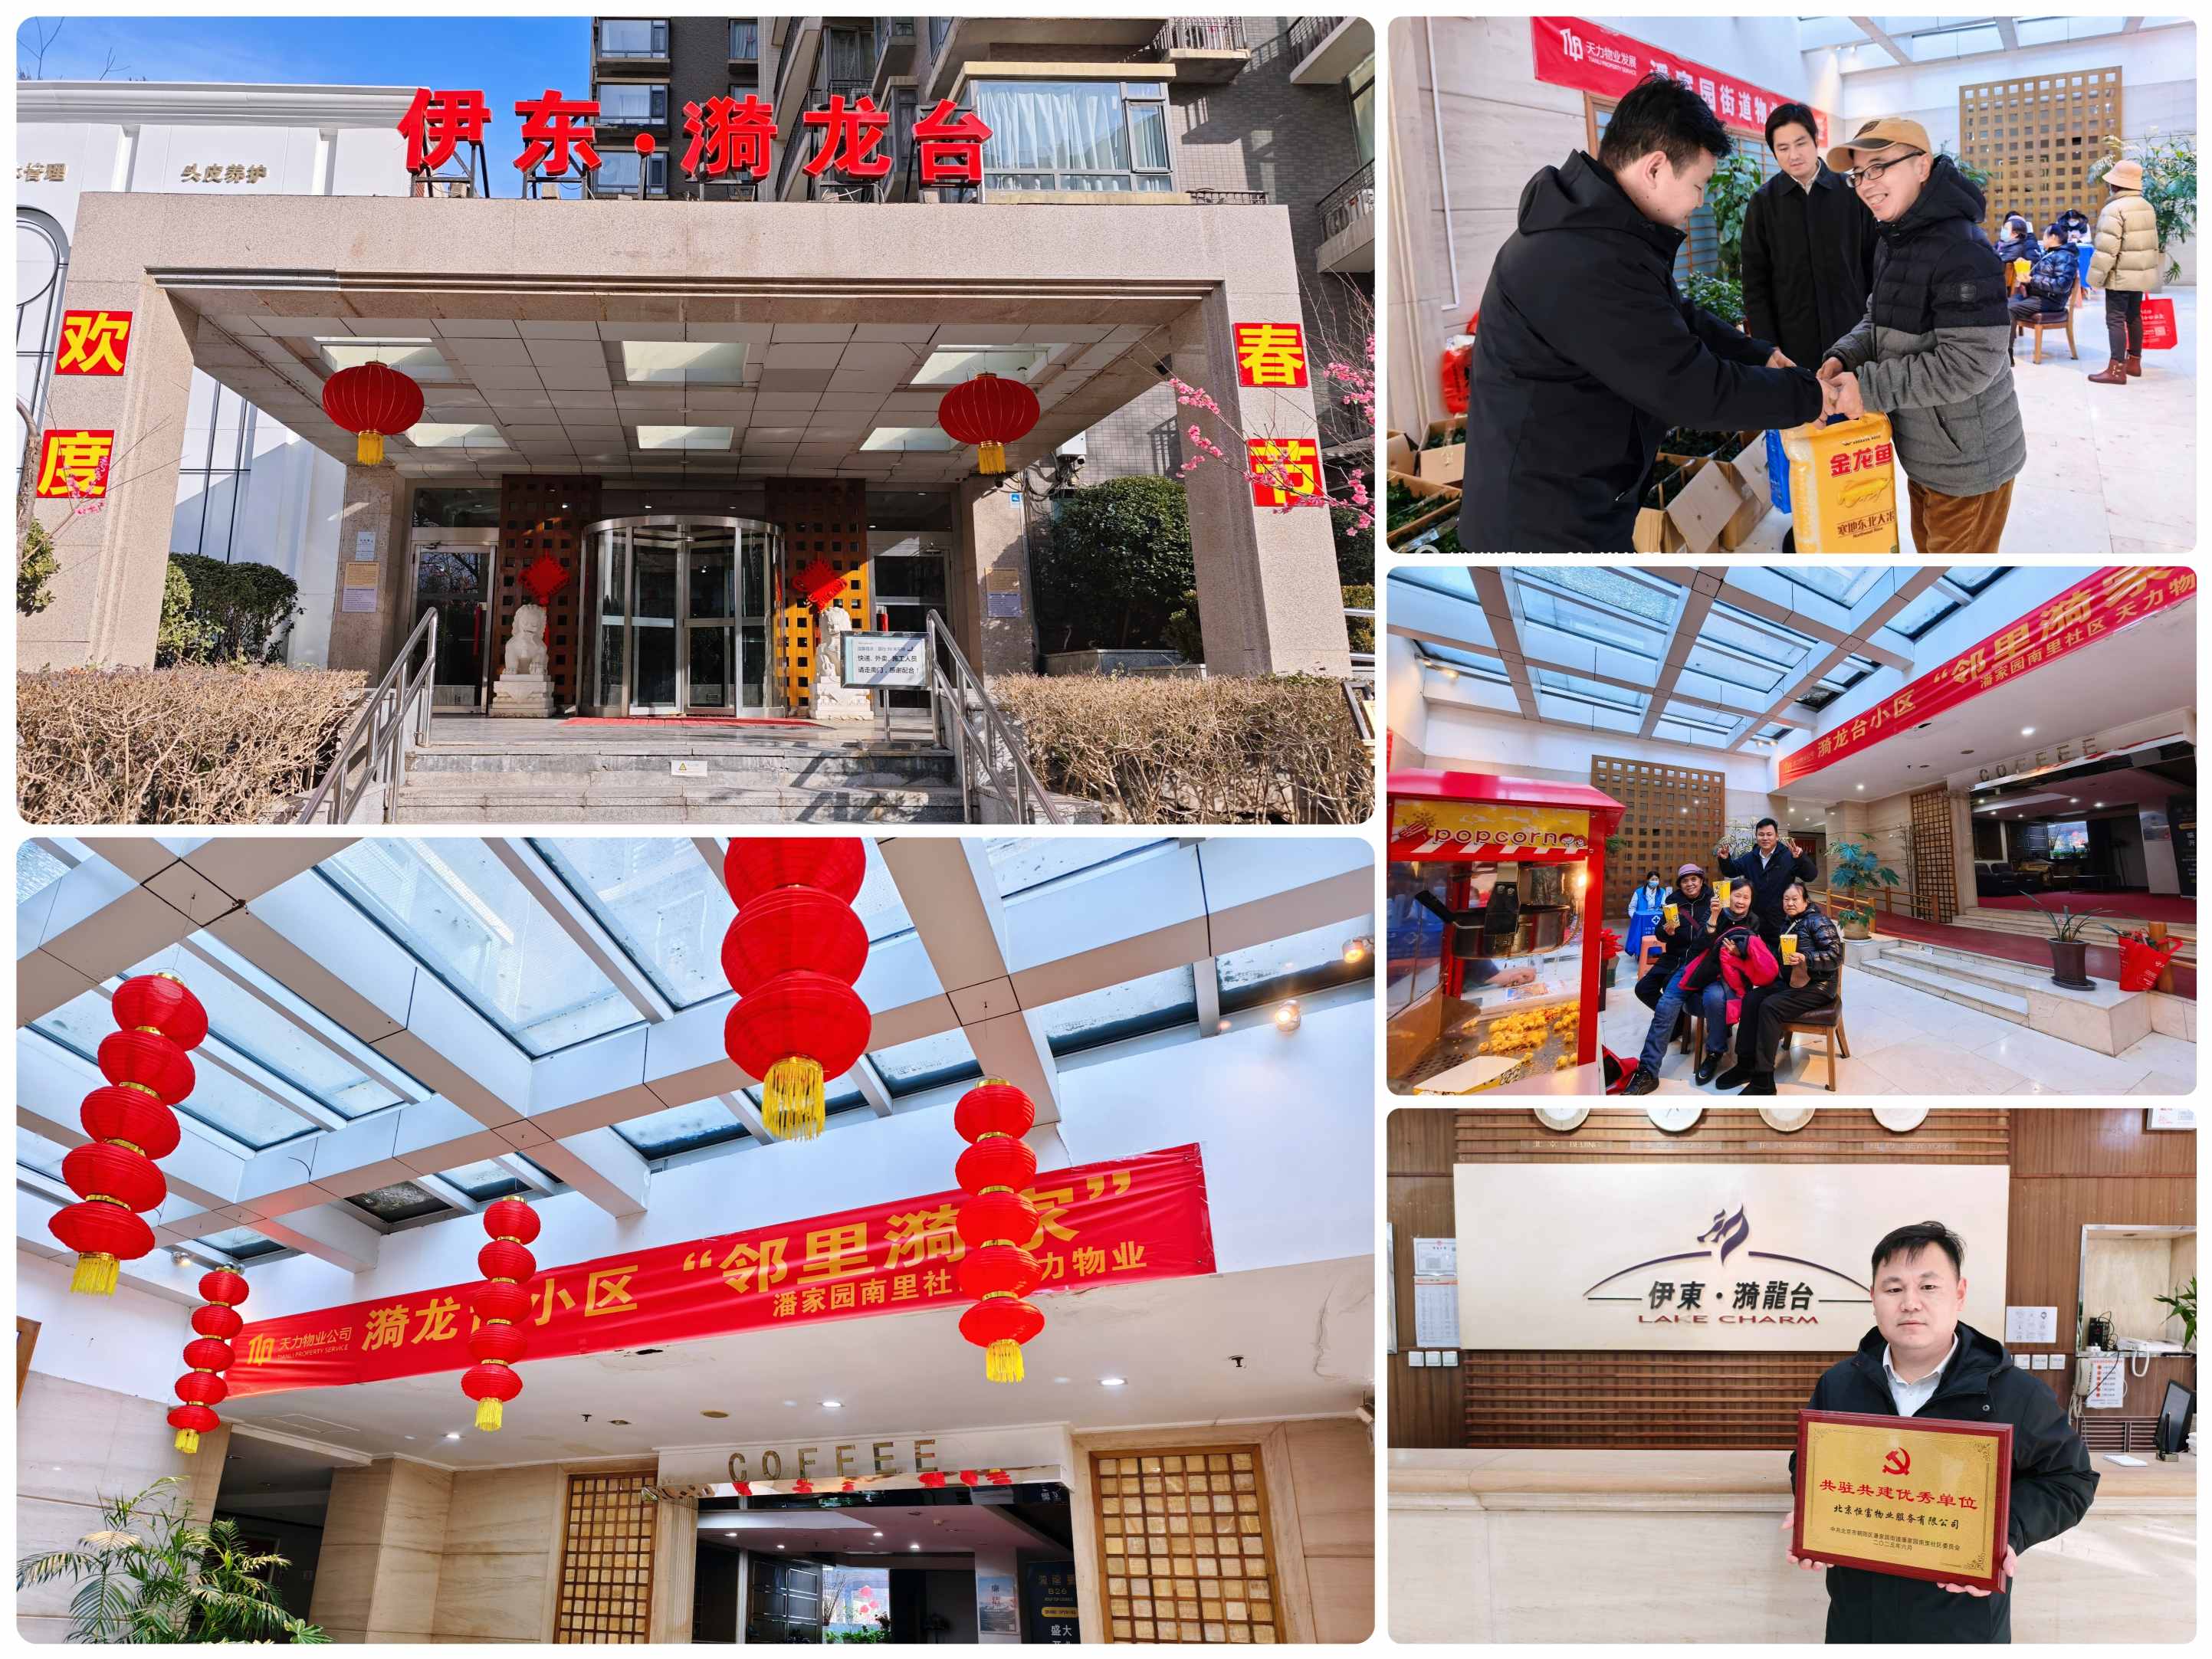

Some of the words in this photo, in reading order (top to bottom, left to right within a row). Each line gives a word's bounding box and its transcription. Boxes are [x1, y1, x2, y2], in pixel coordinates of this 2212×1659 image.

[1586, 41, 1637, 70] 天力物业发展
[16, 162, 67, 182] 管理
[181, 163, 267, 183] 头皮养护
[1830, 442, 1892, 477] 金龙鱼
[1980, 618, 2107, 689] 潘家园南里社区
[1817, 690, 1916, 758] 漪龙台小区
[1979, 737, 2097, 782] COFFEE
[1434, 828, 1557, 846] popcorn
[772, 1268, 963, 1318] 潘家园南里社
[1036, 1241, 1147, 1282] 力物业
[362, 1264, 638, 1351] 漪龙小区
[1639, 1314, 1708, 1323] LAKE
[1719, 1314, 1819, 1324] CHARM
[277, 1326, 353, 1352] 天力物业公司
[727, 1438, 939, 1483] COFFEE
[1819, 1479, 1978, 1510] 共驻共建优秀单位
[1833, 1503, 1960, 1530] 北京恒富物业服务有限公司
[1051, 1625, 1073, 1637] 盛大
